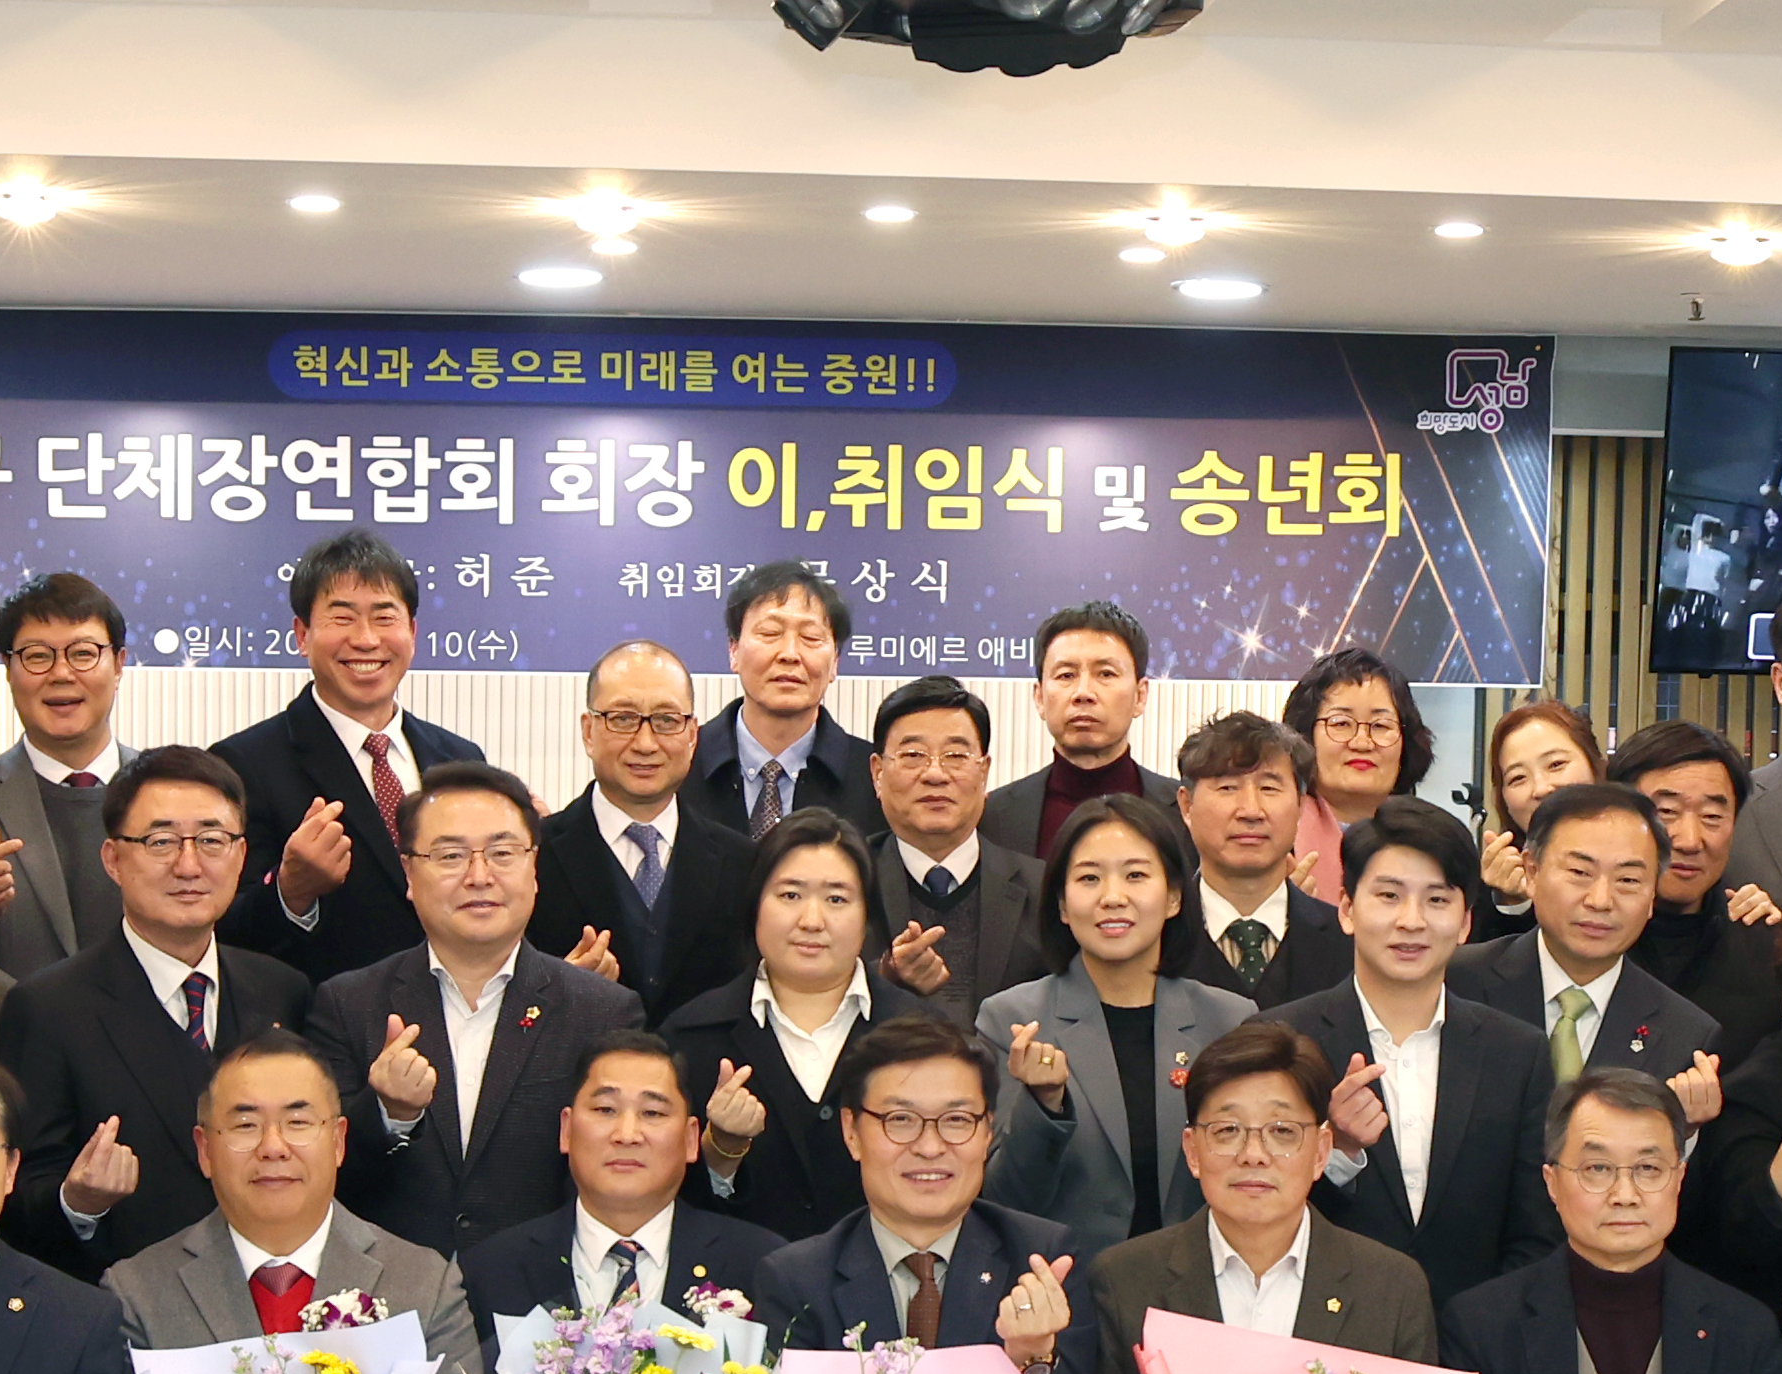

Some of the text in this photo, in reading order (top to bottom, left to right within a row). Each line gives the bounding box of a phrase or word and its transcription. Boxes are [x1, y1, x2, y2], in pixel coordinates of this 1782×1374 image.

[293, 346, 936, 395] 혁신과 소통으로 미래를 여는 중원!!
[1417, 411, 1477, 434] 희망도시
[37, 432, 515, 525] 단체장연합회
[541, 439, 705, 528] 회장
[727, 442, 1066, 534] 이,취임식
[1095, 466, 1150, 534] 및
[1169, 448, 1403, 538] 송년회
[185, 626, 254, 658] 일시:
[427, 629, 519, 662] 10(수)
[848, 634, 1036, 667] 루미에르 애비
